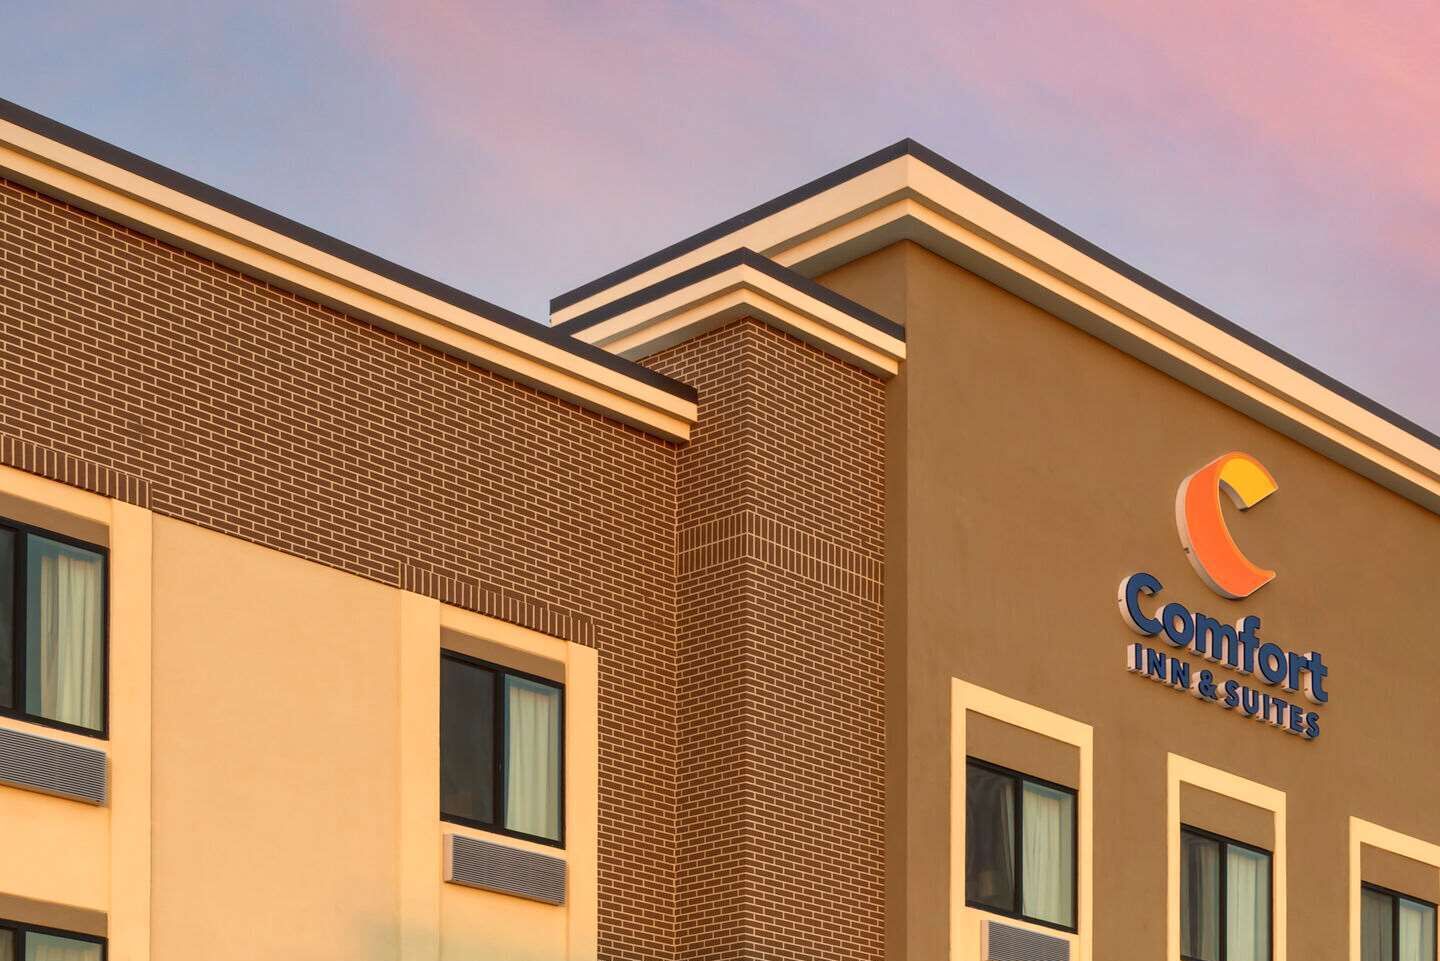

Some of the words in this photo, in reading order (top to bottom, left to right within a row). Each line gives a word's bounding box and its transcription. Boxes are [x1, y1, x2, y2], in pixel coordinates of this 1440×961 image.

[1118, 572, 1328, 704] Comfort
[1128, 643, 1190, 691] INN
[1192, 670, 1217, 701] &
[1218, 679, 1320, 740] SUITES
